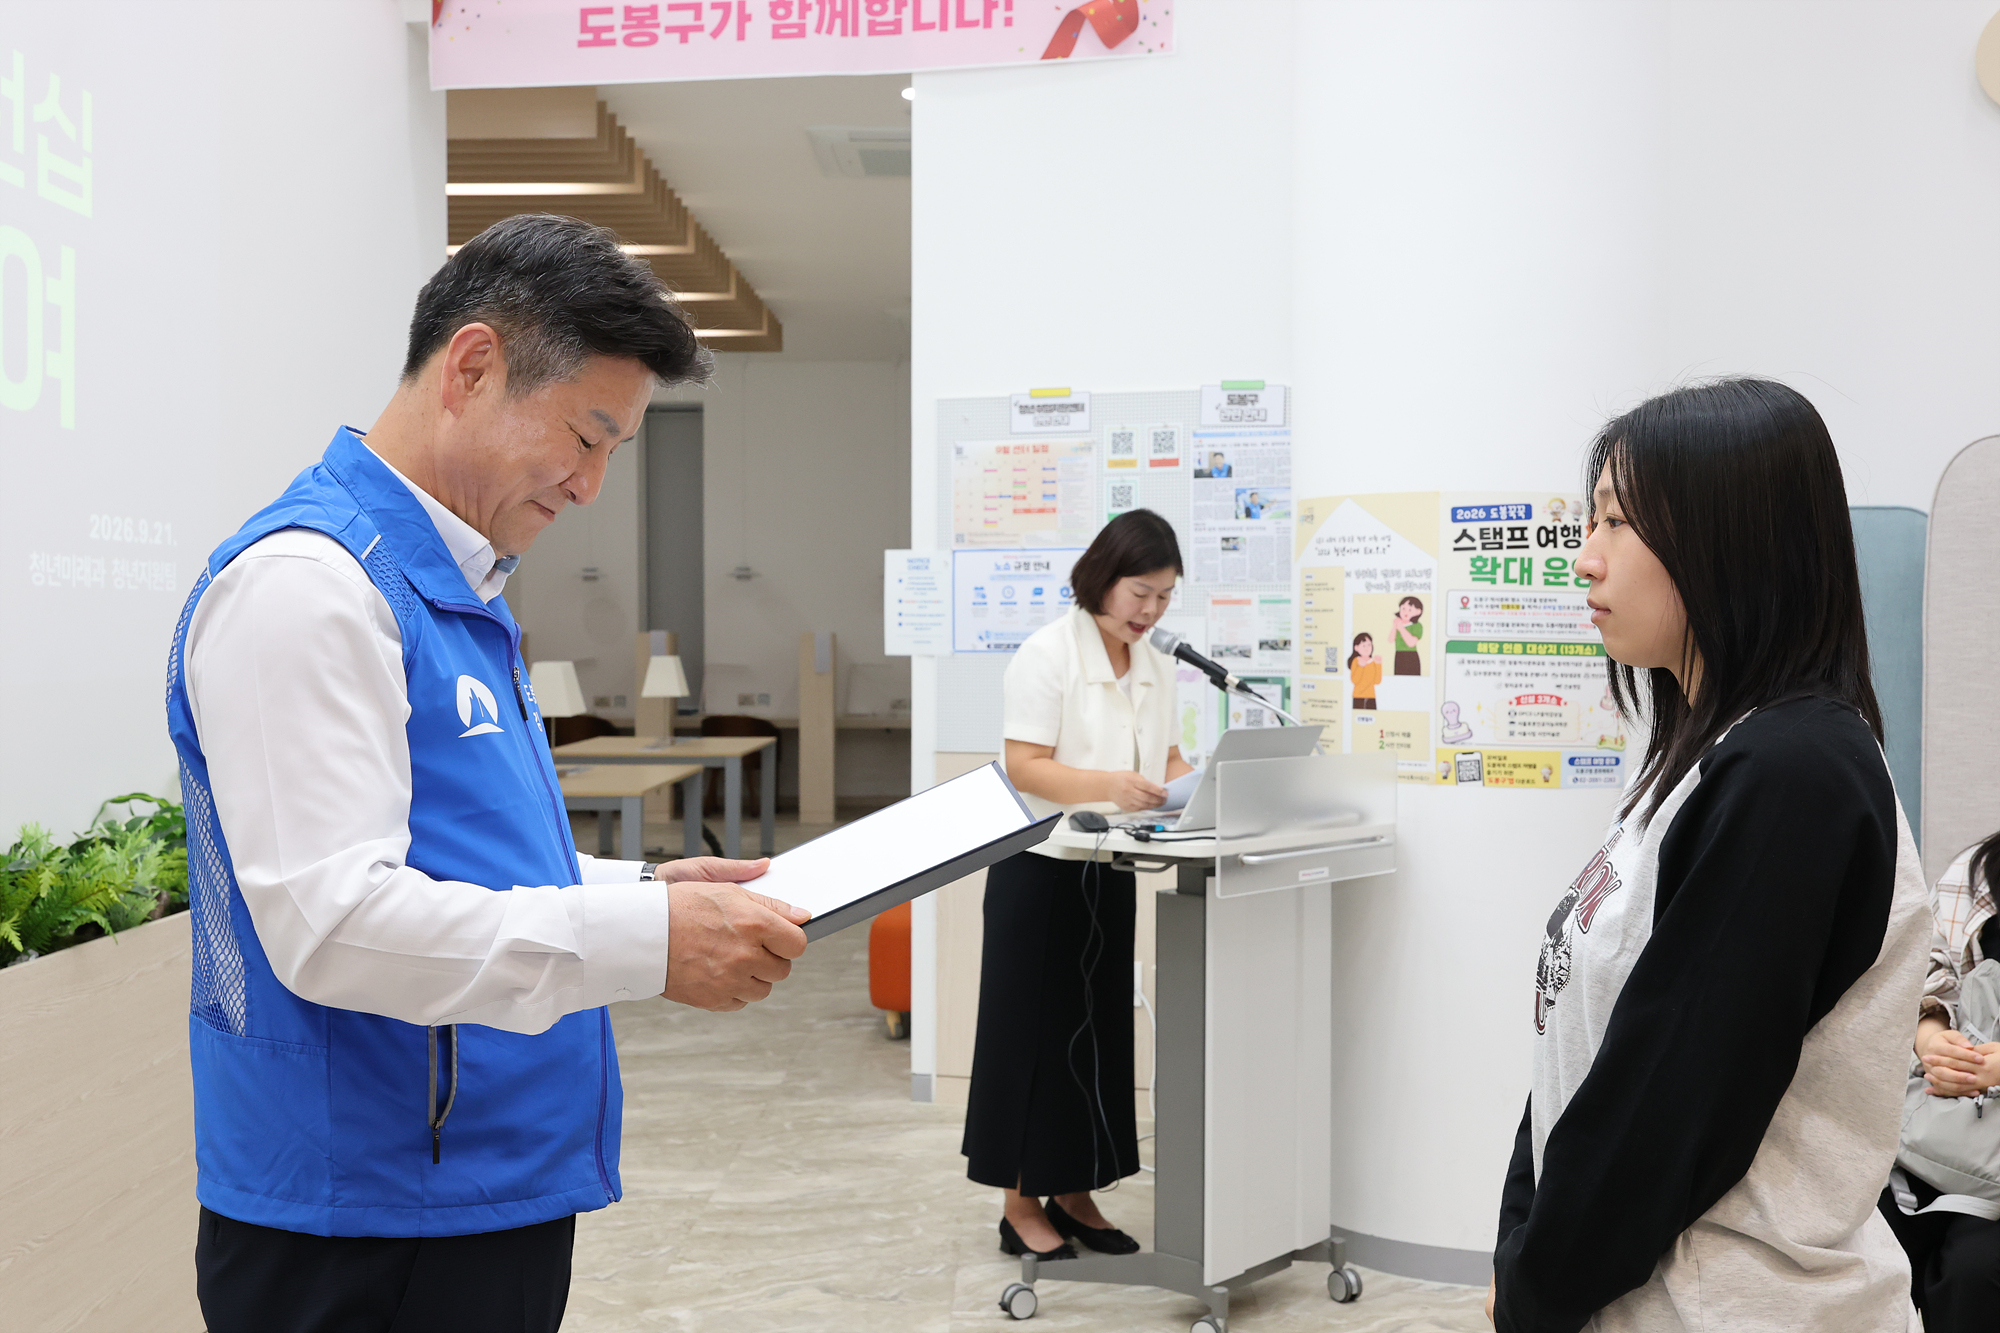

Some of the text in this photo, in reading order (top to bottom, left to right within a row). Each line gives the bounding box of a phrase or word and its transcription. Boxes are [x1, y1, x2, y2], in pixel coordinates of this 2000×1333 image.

[577, 0, 1015, 48] 도봉구가 함께합니다!
[1456, 505, 1526, 519] 2026 도봉꾹꾹
[89, 513, 178, 547] 2026.9.21.
[1453, 525, 1581, 551] 스탬프 여행
[29, 550, 177, 592] 청년미래과 청년지원팀
[1033, 561, 1050, 570] 안내
[1470, 555, 1532, 585] 확대
[1477, 642, 1596, 655] 해당 인증 대상지 (13개소)
[1379, 740, 1384, 749] 2
